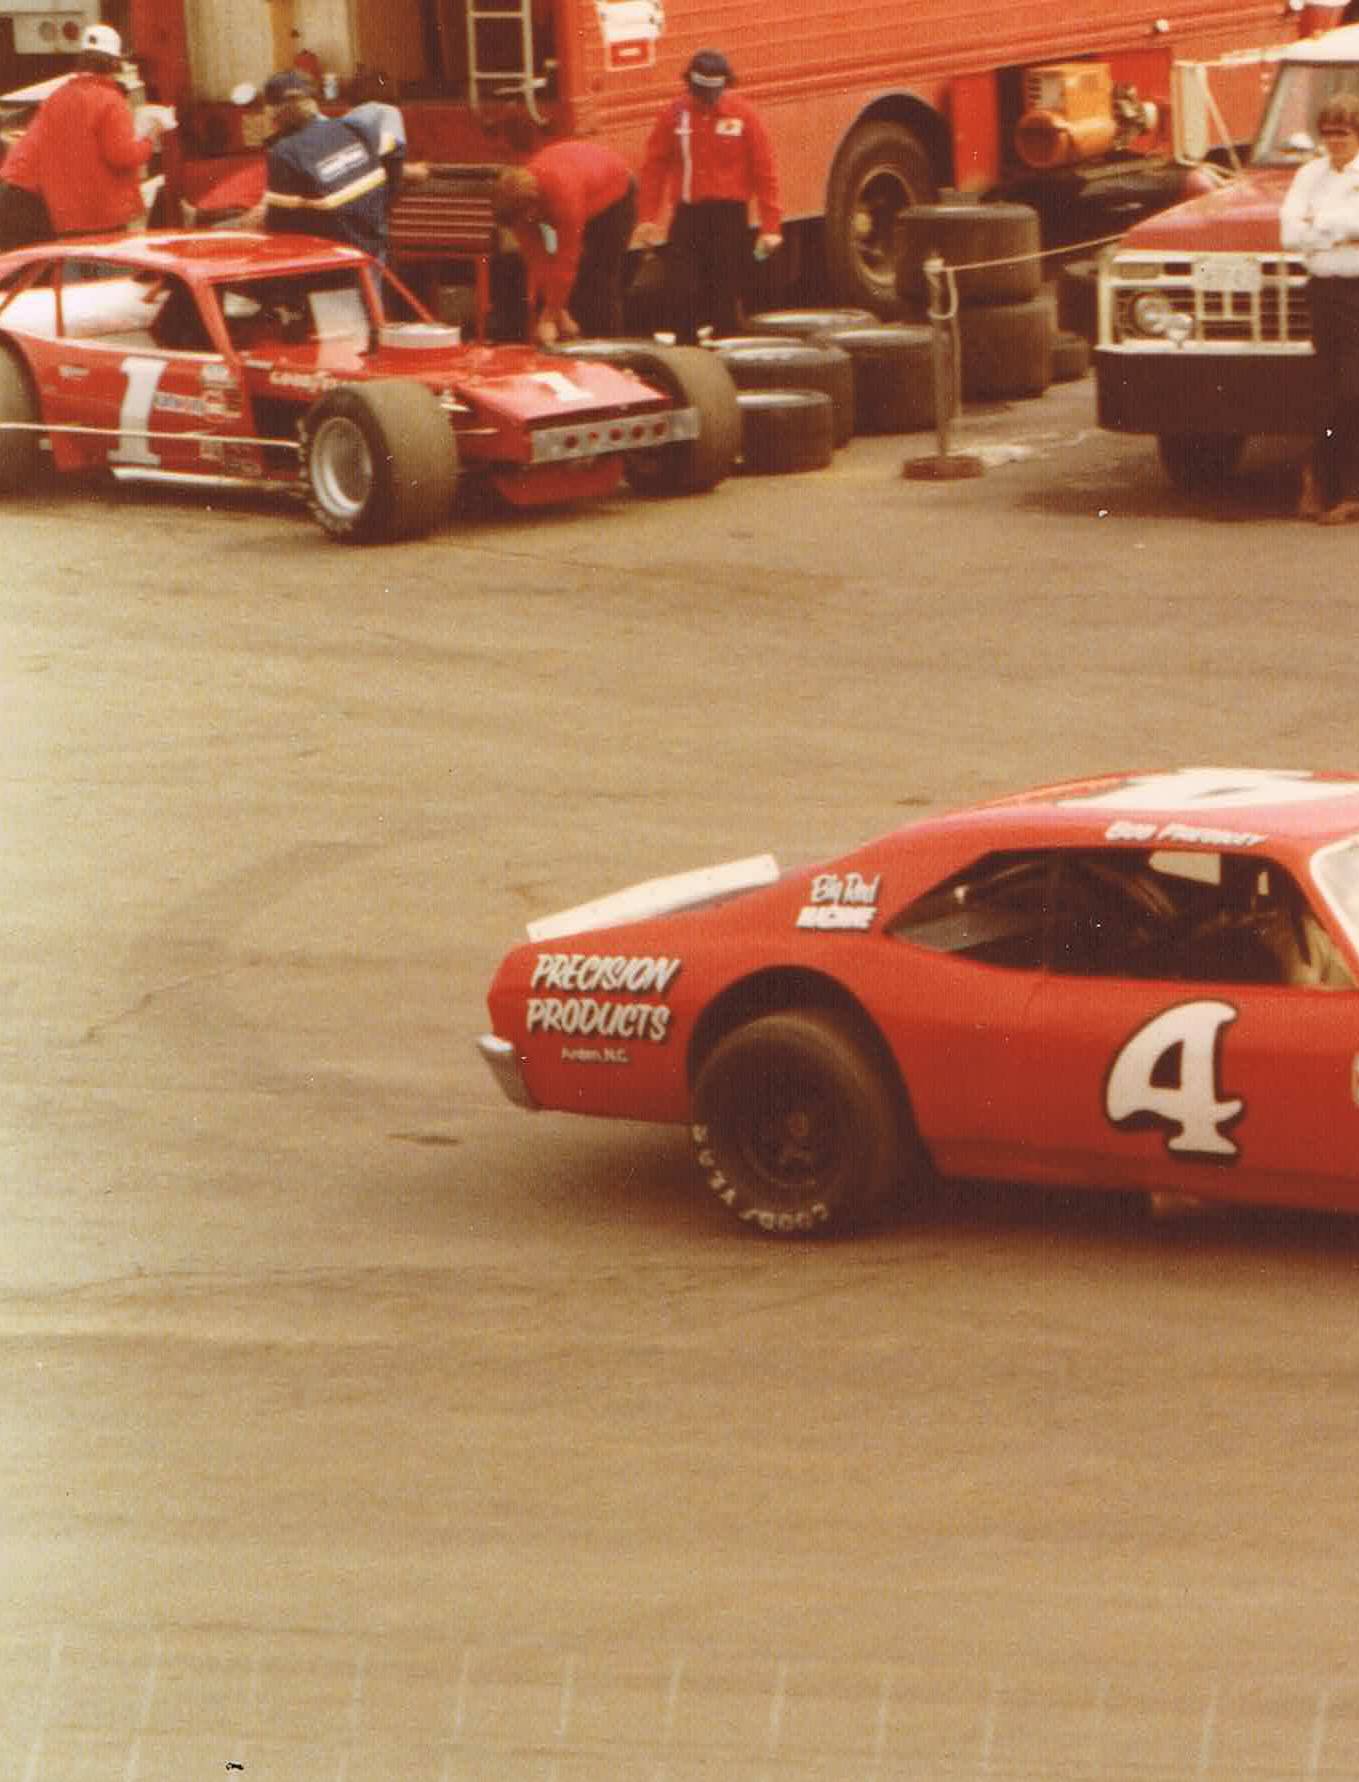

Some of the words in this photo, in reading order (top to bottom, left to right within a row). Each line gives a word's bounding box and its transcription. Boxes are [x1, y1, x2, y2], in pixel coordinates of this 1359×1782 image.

[107, 356, 168, 464] 1
[530, 953, 682, 993] PRECISION
[526, 997, 671, 1041] PRODUCTS
[1106, 1000, 1244, 1156] 4
